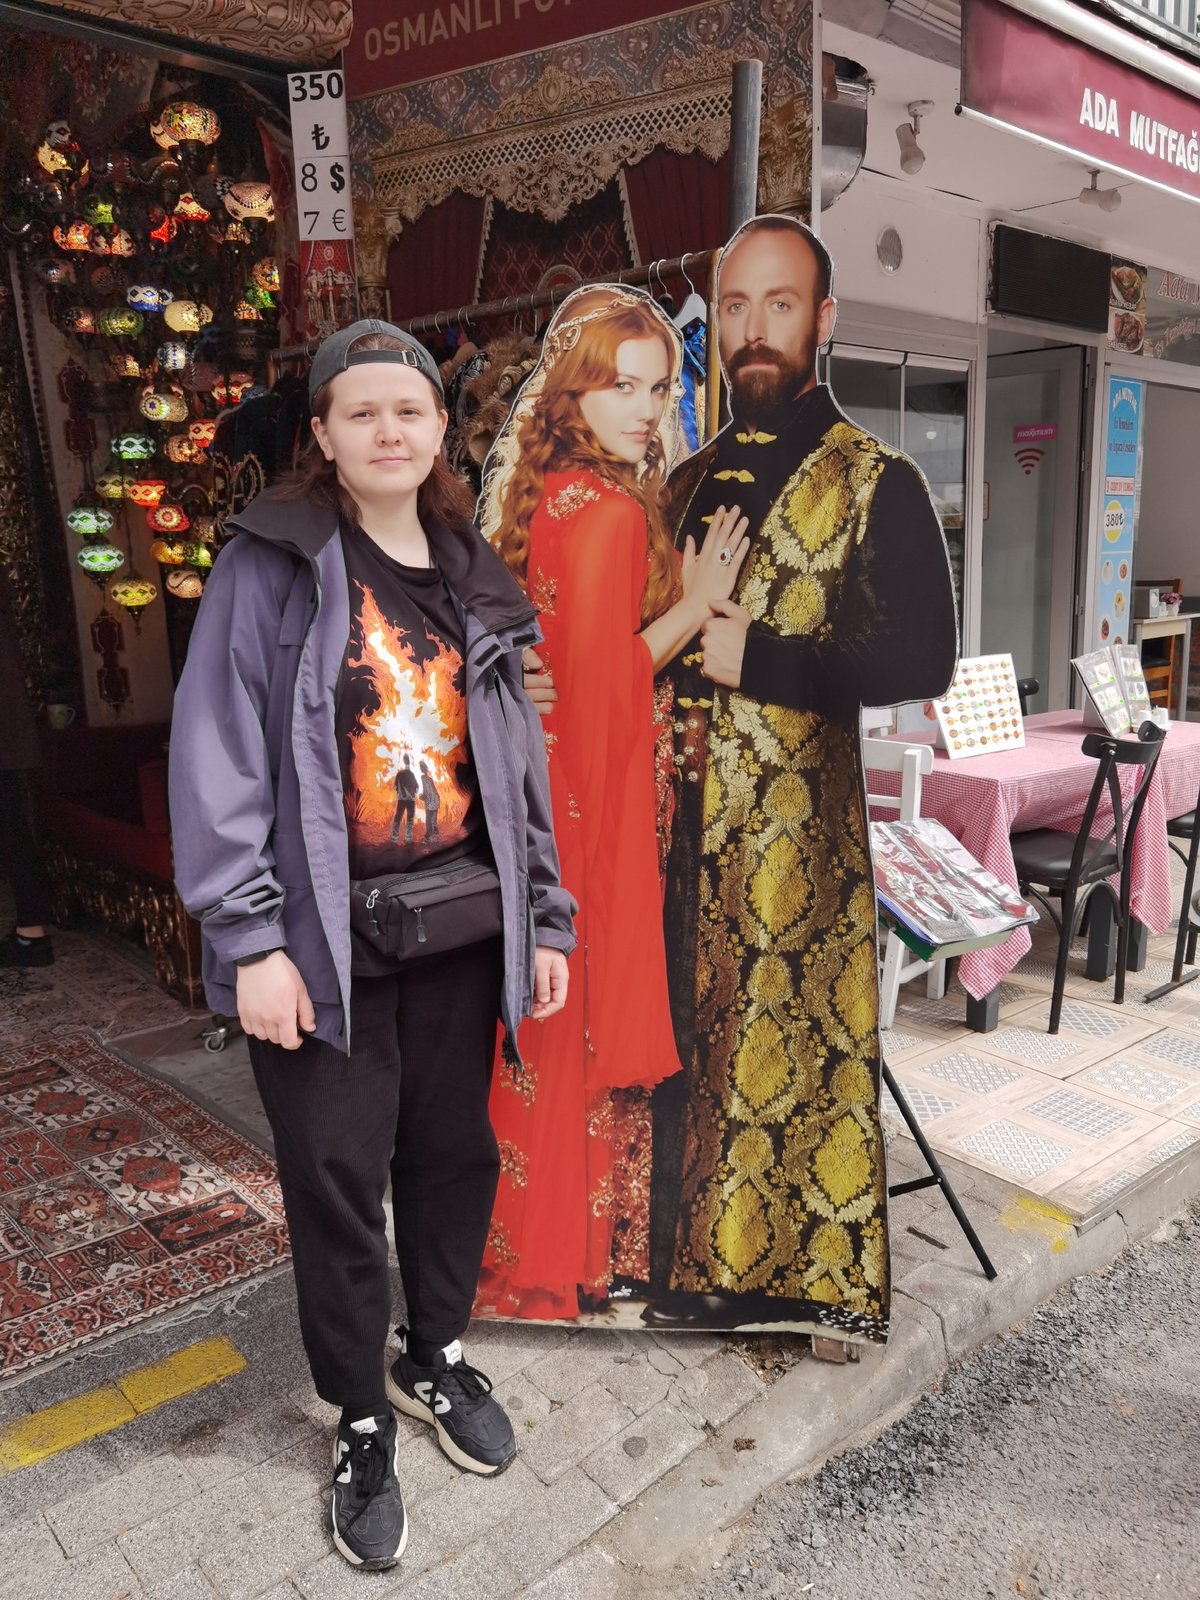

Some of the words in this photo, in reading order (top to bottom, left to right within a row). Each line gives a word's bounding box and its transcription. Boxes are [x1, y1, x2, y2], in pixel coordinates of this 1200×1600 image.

[364, 0, 501, 61] OSMANLI
[290, 72, 344, 102] 350
[311, 123, 330, 151] ₺
[1079, 87, 1120, 138] ADA
[1129, 110, 1200, 175] MUTFAĞ
[301, 162, 318, 192] 8
[329, 161, 346, 194] $
[303, 210, 321, 235] 7
[332, 208, 347, 233] €
